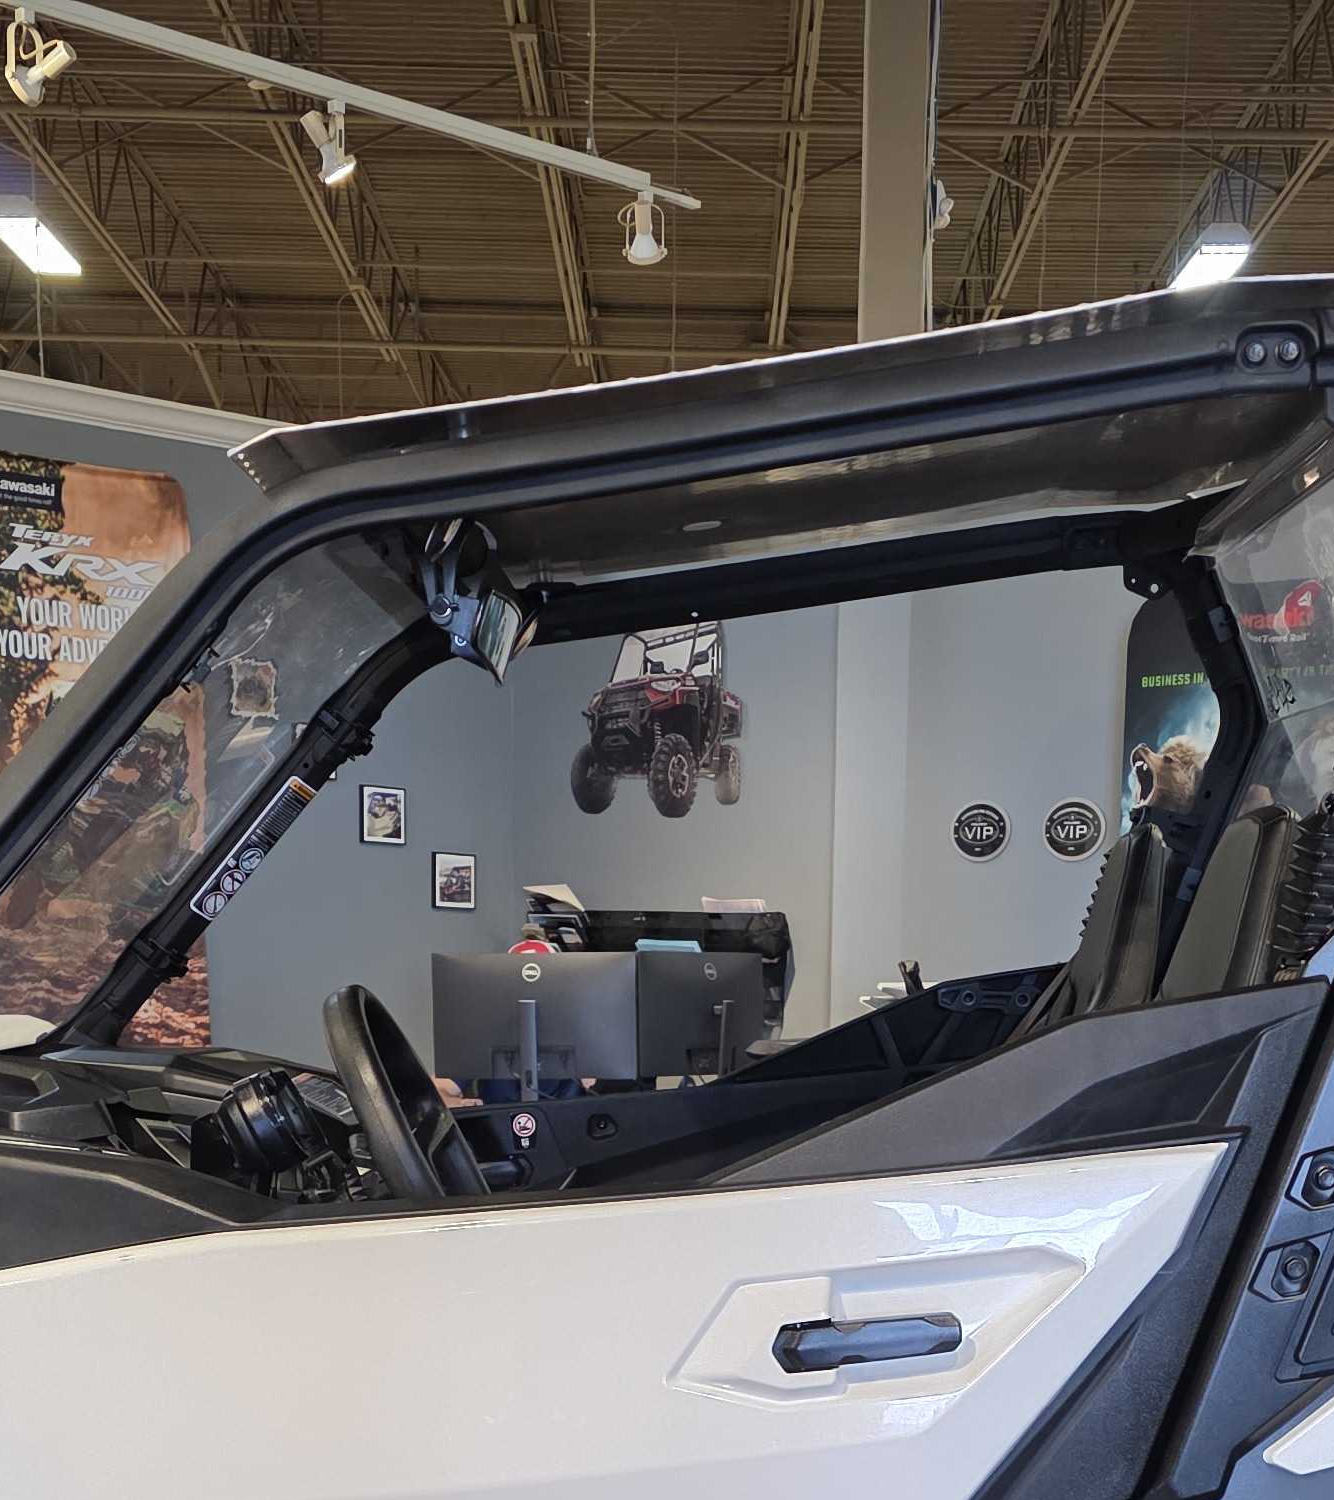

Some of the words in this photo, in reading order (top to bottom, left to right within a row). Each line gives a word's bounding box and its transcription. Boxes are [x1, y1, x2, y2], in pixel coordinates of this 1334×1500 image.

[17, 595, 74, 628] YOUR
[1141, 672, 1191, 688] BUSINESS
[1193, 672, 1204, 684] IN
[965, 827, 994, 840] VIP
[1057, 825, 1088, 839] VIP
